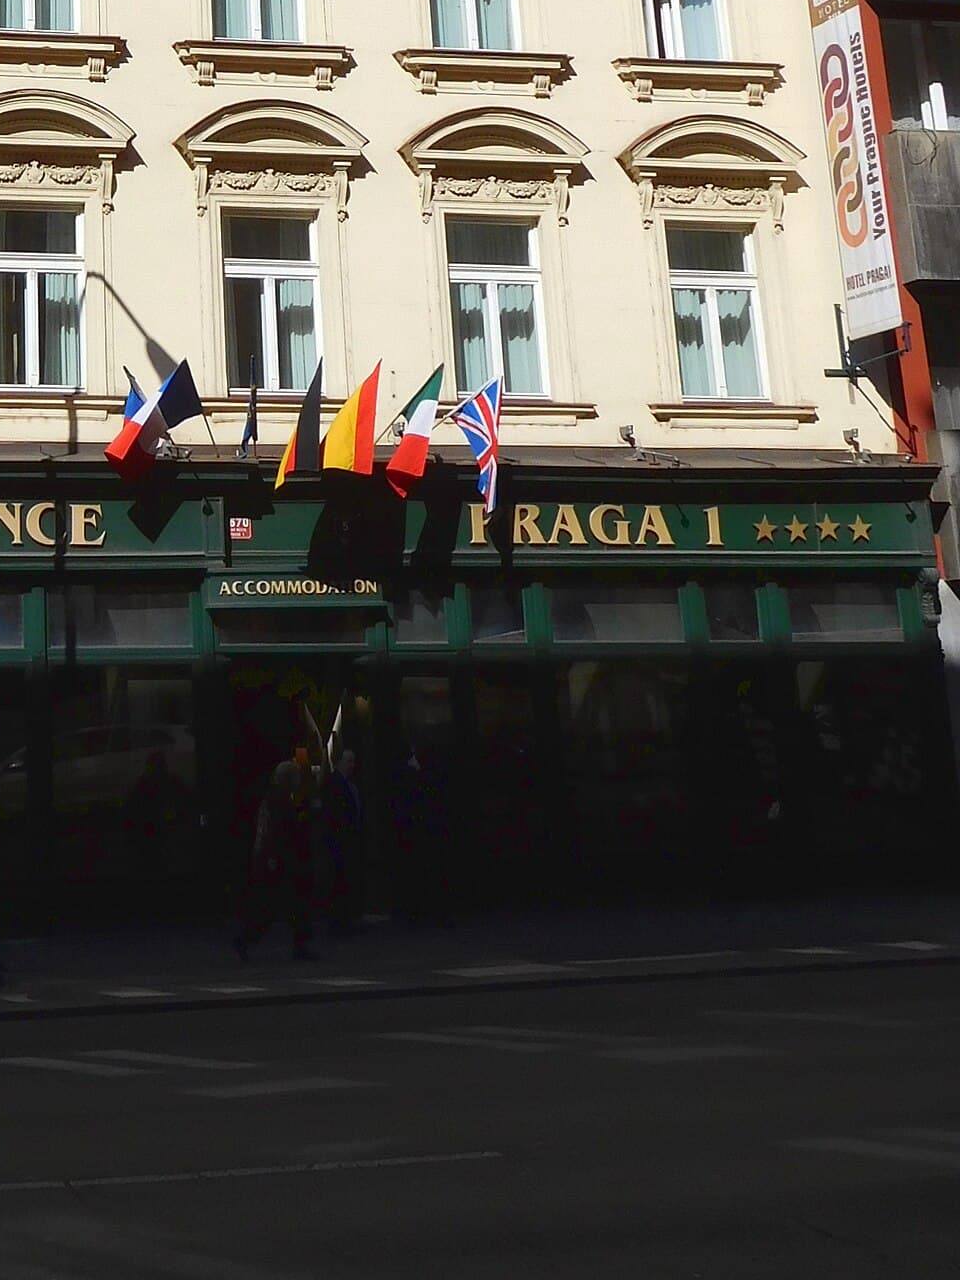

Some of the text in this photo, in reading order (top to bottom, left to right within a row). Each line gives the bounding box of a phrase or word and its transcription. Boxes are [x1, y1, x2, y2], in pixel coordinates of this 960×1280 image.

[850, 32, 886, 240] Your Prague Hotels
[846, 273, 865, 291] HOTEL
[703, 506, 725, 547] 1
